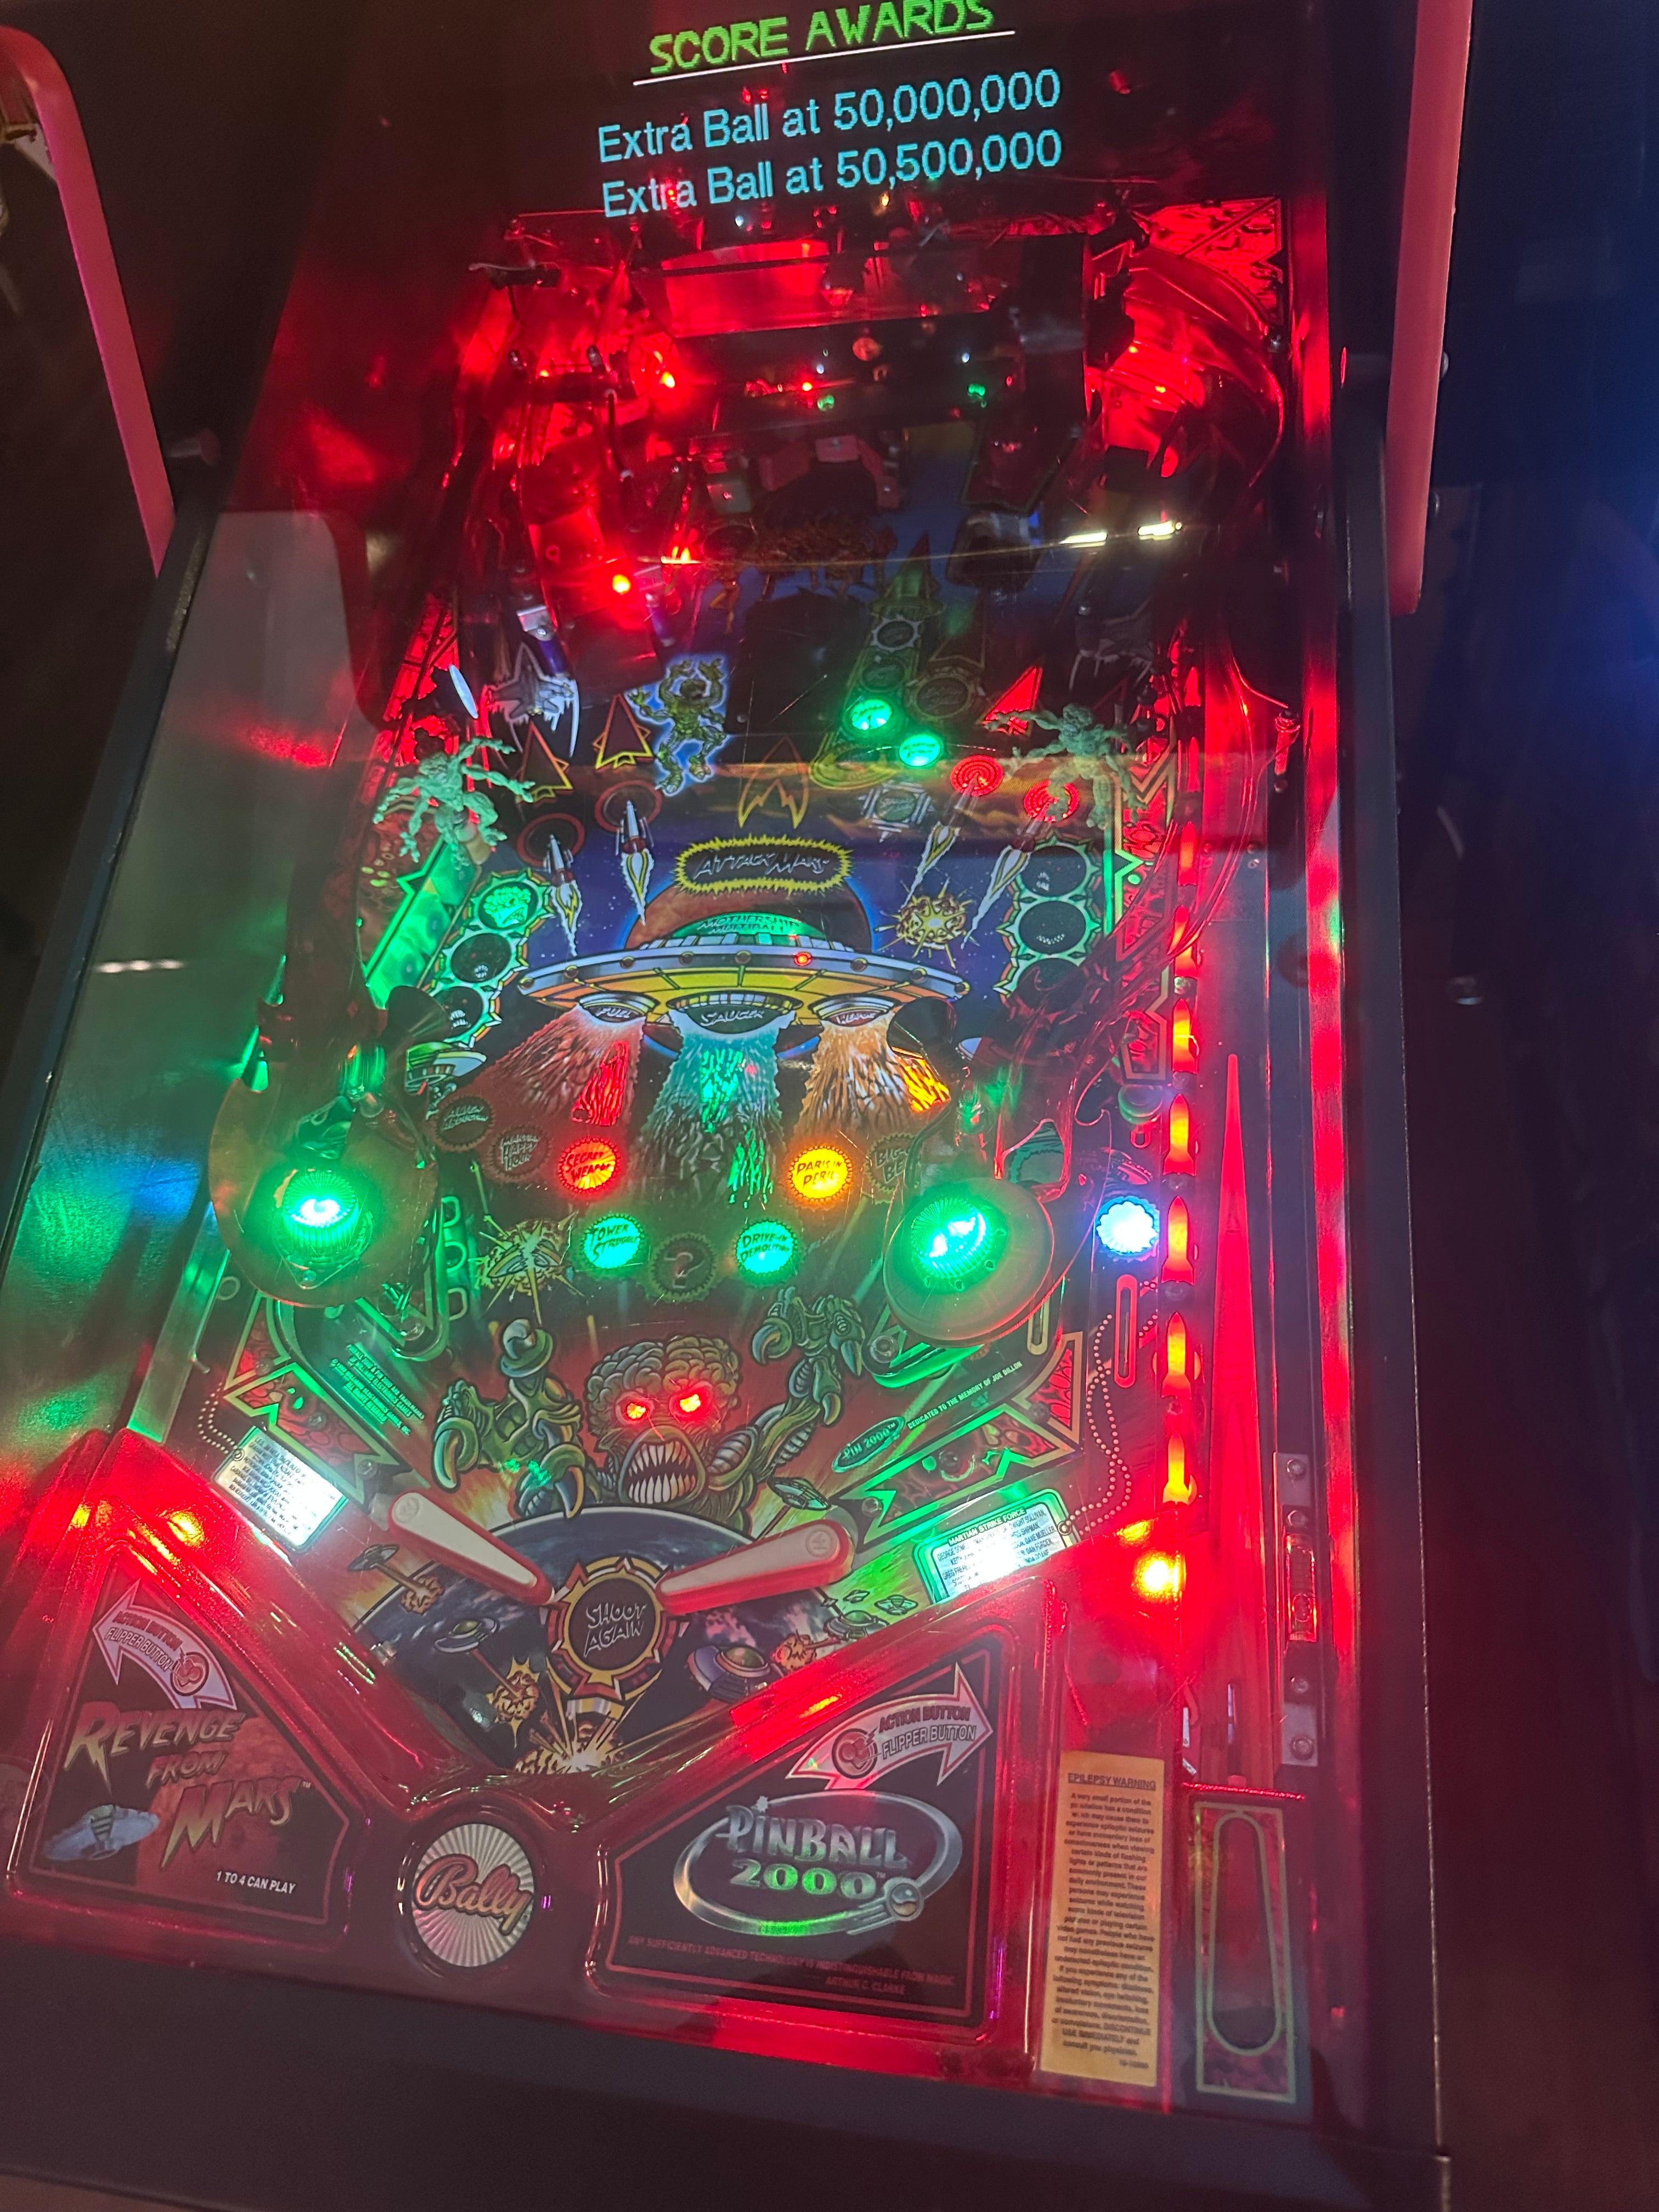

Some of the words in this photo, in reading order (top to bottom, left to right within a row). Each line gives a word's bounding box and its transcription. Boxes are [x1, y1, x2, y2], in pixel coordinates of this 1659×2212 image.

[650, 16, 789, 74] SCORE
[805, 0, 994, 52] AWARDS
[598, 120, 692, 163] Extra
[704, 103, 769, 146] Ball
[782, 99, 822, 138] at
[834, 69, 1061, 132] 50,000,000
[602, 178, 697, 218] Extra
[707, 161, 773, 204] Ball
[786, 156, 824, 195] at
[836, 129, 1062, 189] 50,500,000
[693, 852, 775, 880] ATTACK
[697, 915, 800, 930] MOTHERSHIP
[596, 1007, 632, 1018] FUEL
[701, 1010, 765, 1026] SAUCER
[504, 1154, 532, 1172] HOUR
[565, 1152, 604, 1172] SECRET
[570, 1164, 610, 1183] WEAPON
[797, 1160, 830, 1175] PARIS
[803, 1171, 834, 1189] PERIL
[590, 1224, 629, 1249] TOWER
[743, 1233, 788, 1248] DRIVE-IN
[371, 1378, 399, 1404] ELECTRONICS
[395, 1401, 413, 1418] GAMES
[908, 1407, 939, 1429] DEDICATED
[939, 1403, 947, 1412] TO
[946, 1396, 959, 1408] THE
[958, 1382, 984, 1402] MEMORY
[984, 1378, 991, 1387] OF
[991, 1372, 1003, 1384] JOE
[1002, 1361, 1023, 1376] DILLON
[843, 1444, 863, 1459] PIN
[949, 1527, 978, 1546] MARTIAN
[978, 1517, 1003, 1533] STRIKE
[1003, 1508, 1026, 1524] FORCE
[1025, 1534, 1037, 1544] DAVE
[937, 1548, 956, 1561] GEORGE
[1026, 1546, 1035, 1555] DAN
[586, 1602, 647, 1629] SHOOT
[112, 1611, 150, 1630] ACTION
[145, 1621, 183, 1651] BUTTON
[583, 1621, 645, 1658] AGAIN
[104, 1627, 145, 1649] FLIPPER
[140, 1639, 174, 1672] BUTTON
[879, 1707, 921, 1733] ACTION
[923, 1705, 971, 1721] BUTTON
[63, 1700, 246, 1797] REVENGE
[882, 1727, 928, 1759] FLIPPER
[929, 1725, 977, 1742] BUTTON
[145, 1751, 228, 1791] FROM
[1067, 1773, 1110, 1785] EPILEPSY
[1111, 1776, 1156, 1790] WARNING
[216, 1870, 223, 1882] 1
[224, 1872, 238, 1885] TO
[239, 1874, 246, 1887] 4
[247, 1876, 269, 1891] CAN
[269, 1880, 296, 1895] PLAY
[413, 1853, 534, 1936] Bally
[646, 1938, 703, 1955] SUFFICIENTLY
[704, 1945, 748, 1960] ADVANCED
